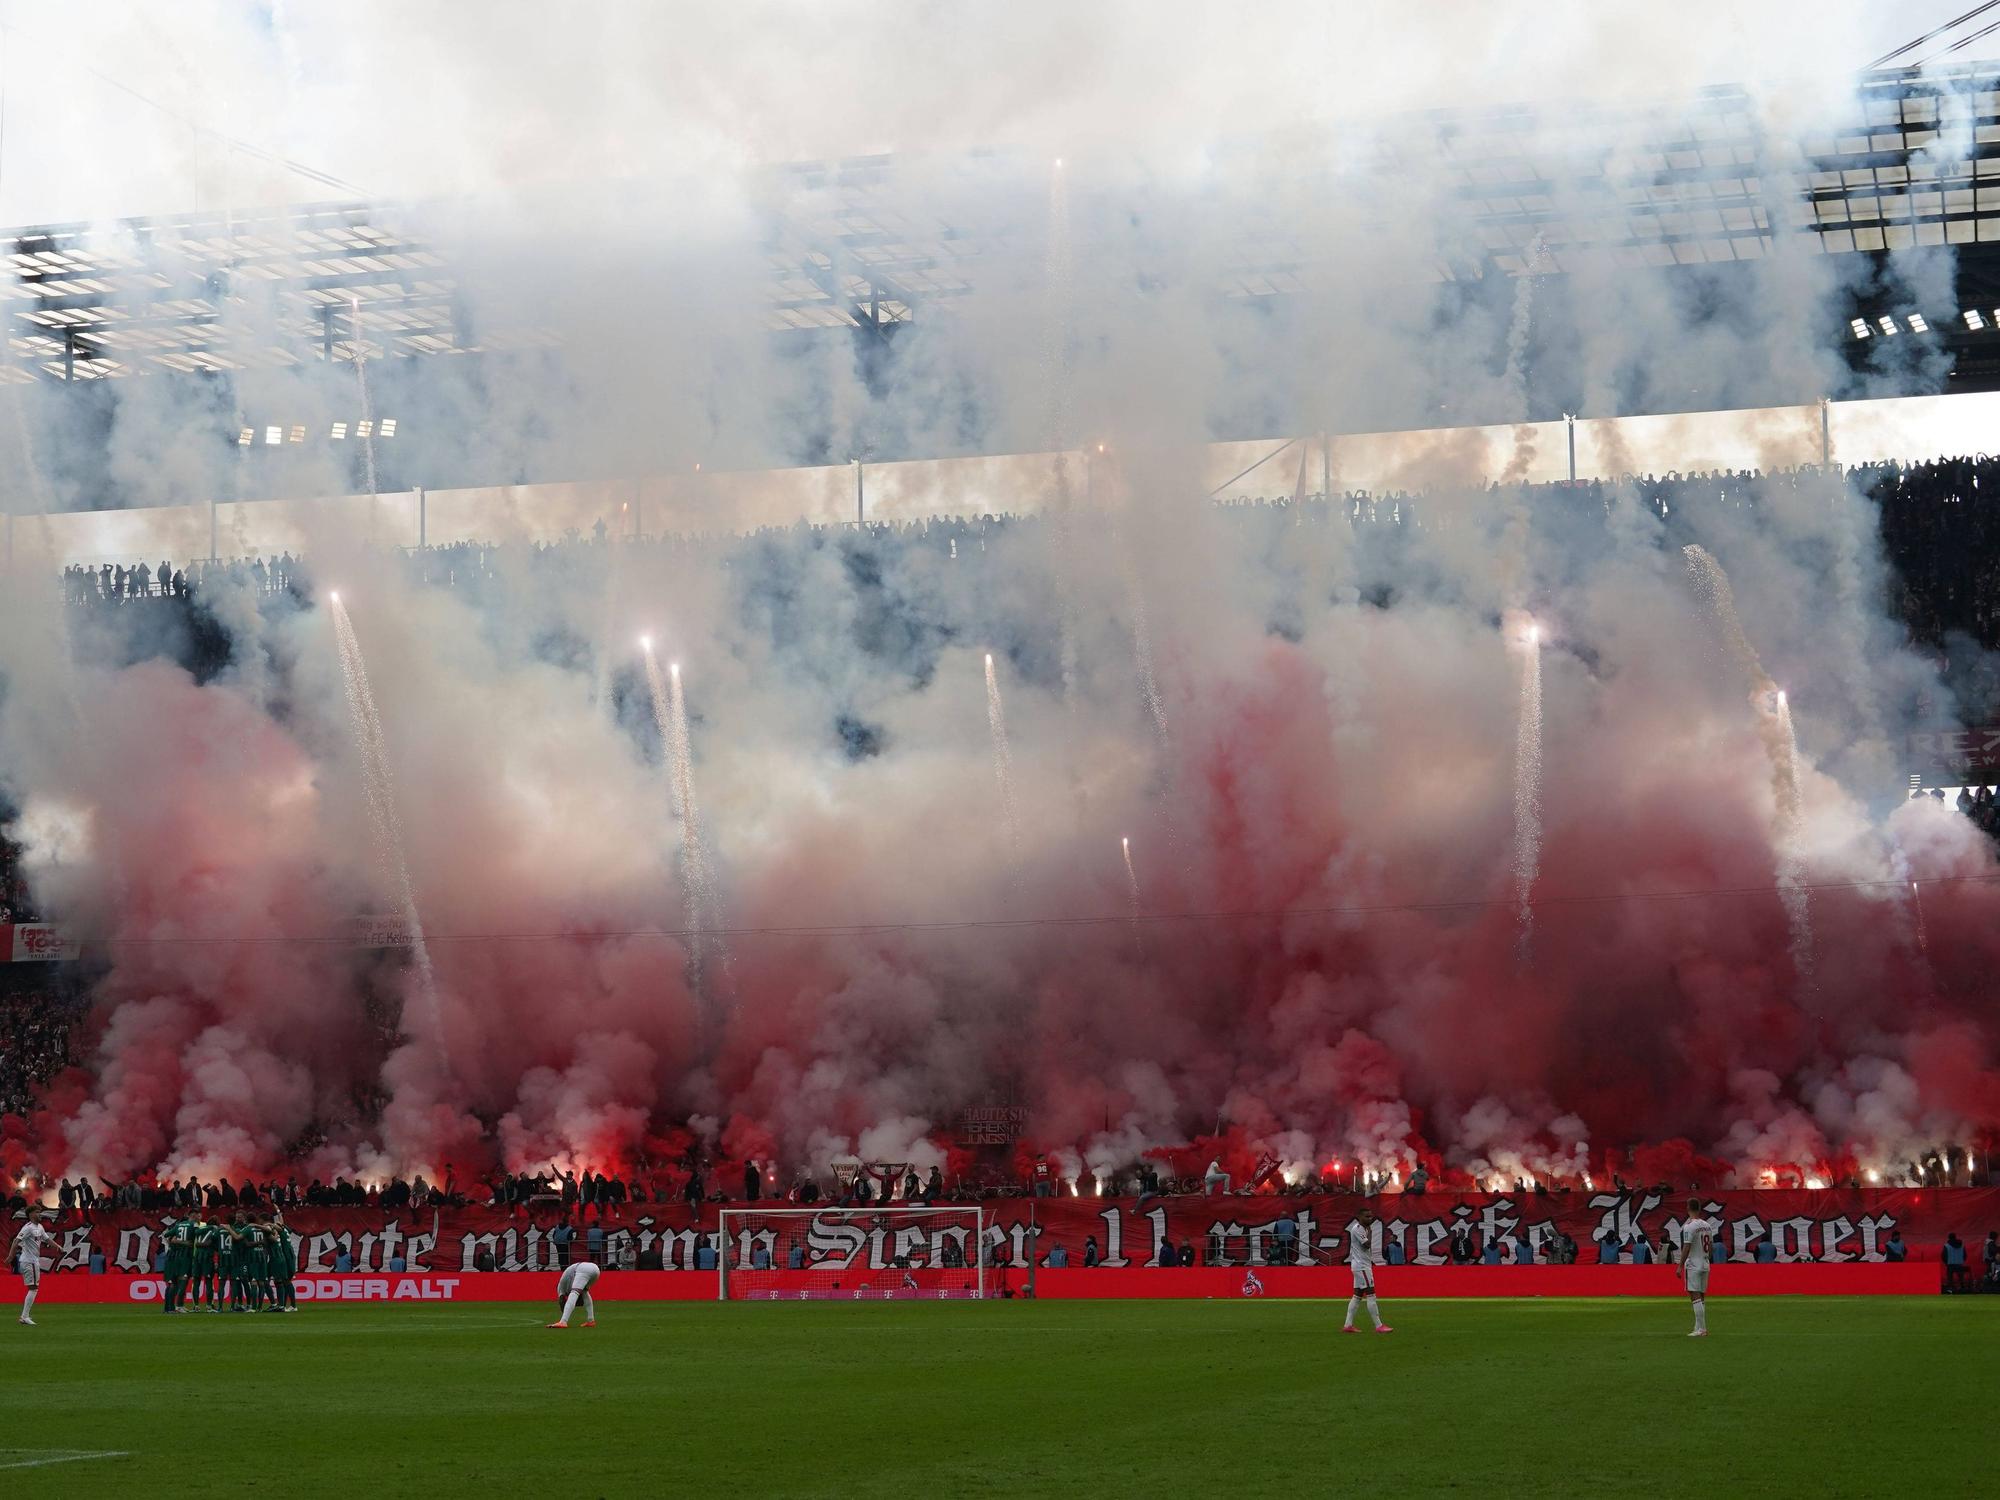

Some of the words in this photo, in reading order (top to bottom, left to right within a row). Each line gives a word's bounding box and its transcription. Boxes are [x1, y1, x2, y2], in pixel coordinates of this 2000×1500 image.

[220, 1234, 232, 1250] 14
[292, 1279, 389, 1299] ODER
[393, 1279, 460, 1299] ALT
